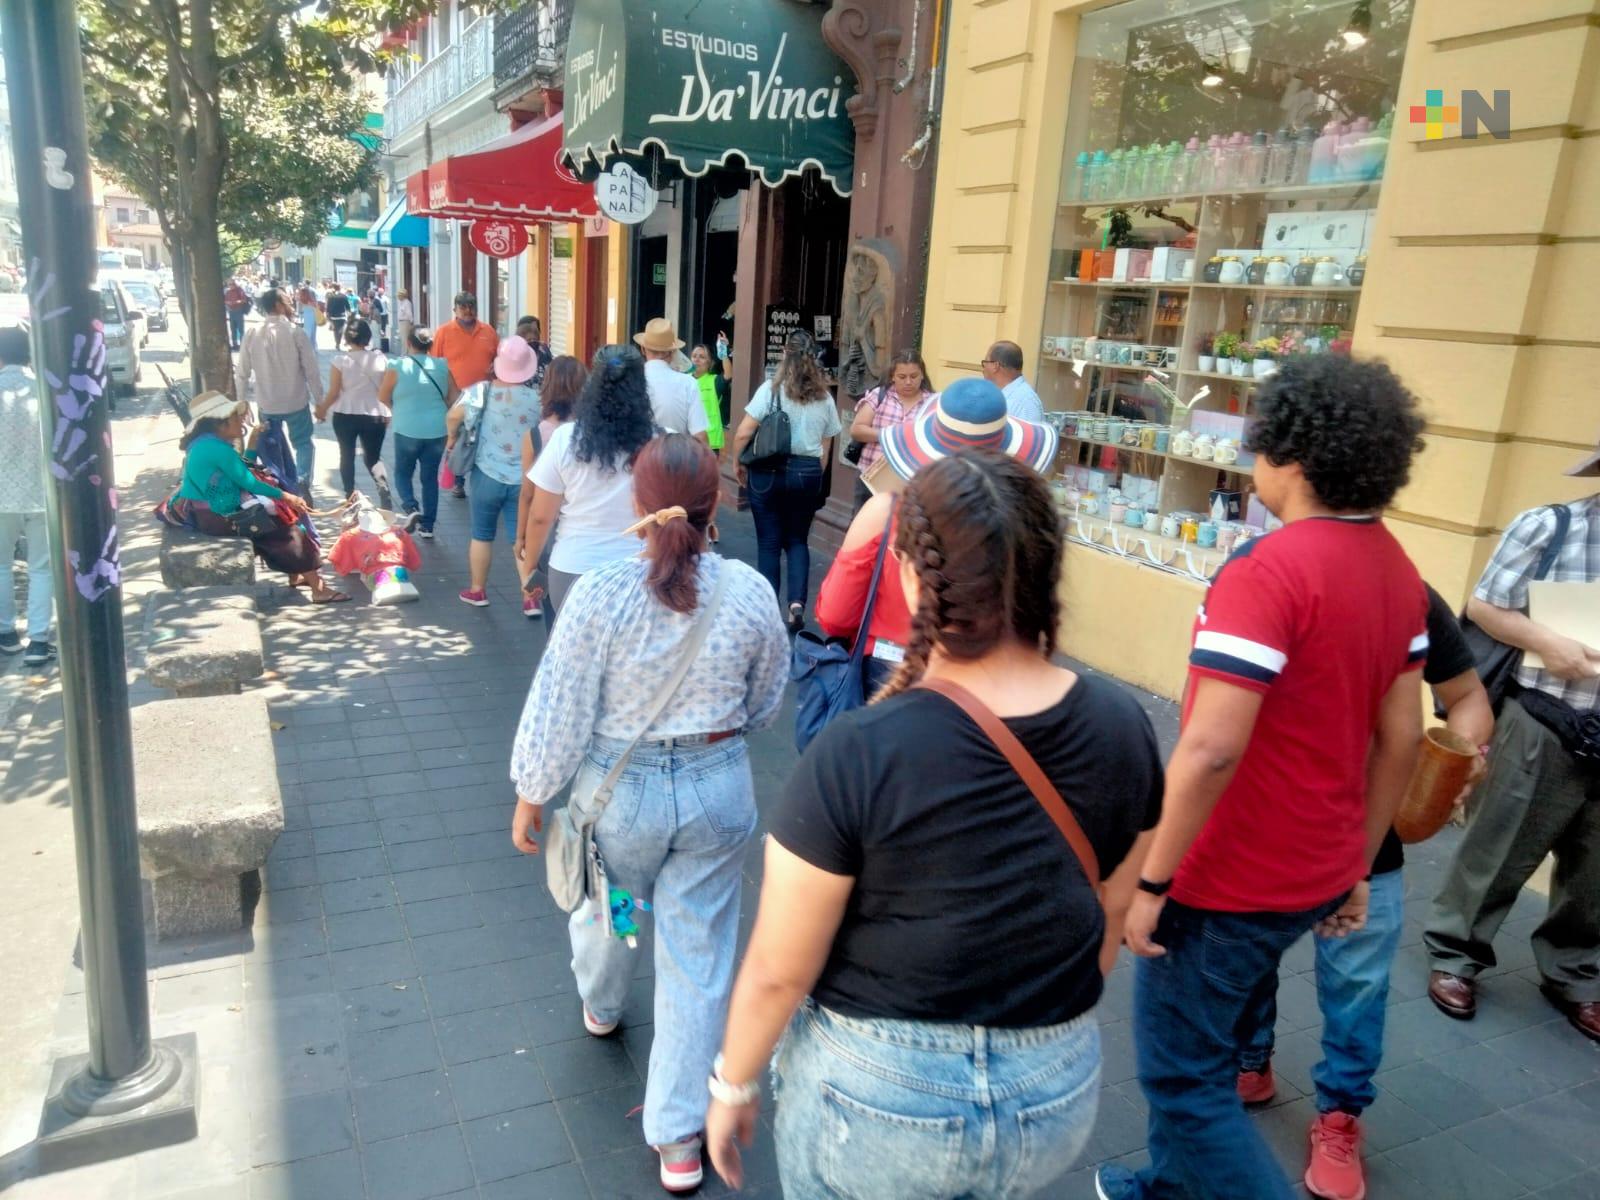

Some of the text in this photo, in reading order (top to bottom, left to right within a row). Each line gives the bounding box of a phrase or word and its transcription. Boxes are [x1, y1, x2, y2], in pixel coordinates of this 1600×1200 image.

[662, 28, 759, 61] ESTUDIOS
[610, 184, 628, 195] PA
[609, 201, 627, 212] NA
